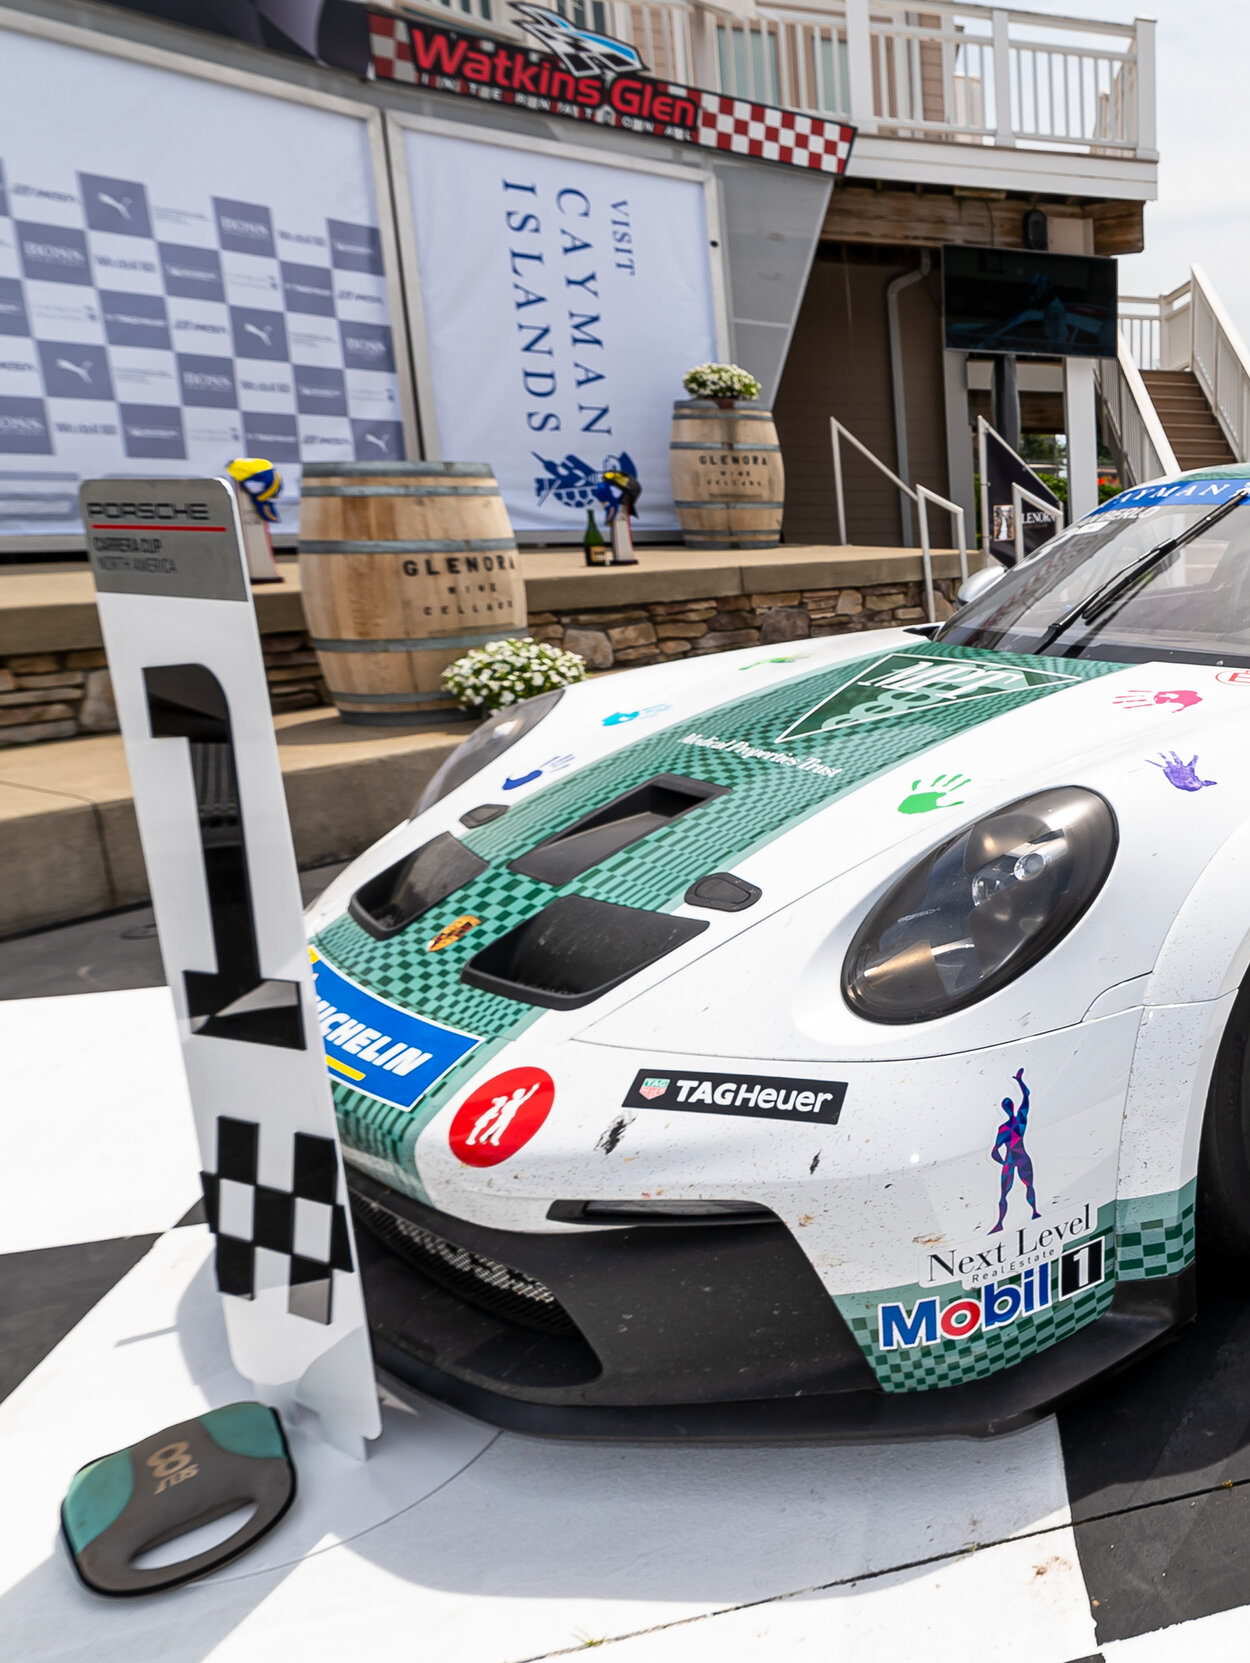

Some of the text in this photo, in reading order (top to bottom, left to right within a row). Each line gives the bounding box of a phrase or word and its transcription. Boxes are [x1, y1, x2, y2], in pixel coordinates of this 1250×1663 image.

[412, 28, 695, 127] Watkins Glen
[610, 200, 635, 276] VISIT
[502, 178, 561, 433] ISLANDS
[555, 188, 612, 436] CAYMAN
[699, 455, 768, 466] GLENORA
[87, 503, 210, 521] PORSCHE
[403, 555, 516, 577] GLENORA
[677, 733, 844, 778] Medical Properties Trust
[142, 663, 307, 1051] 1
[928, 1203, 1092, 1283] Next Level
[879, 1261, 1051, 1350] Mobil
